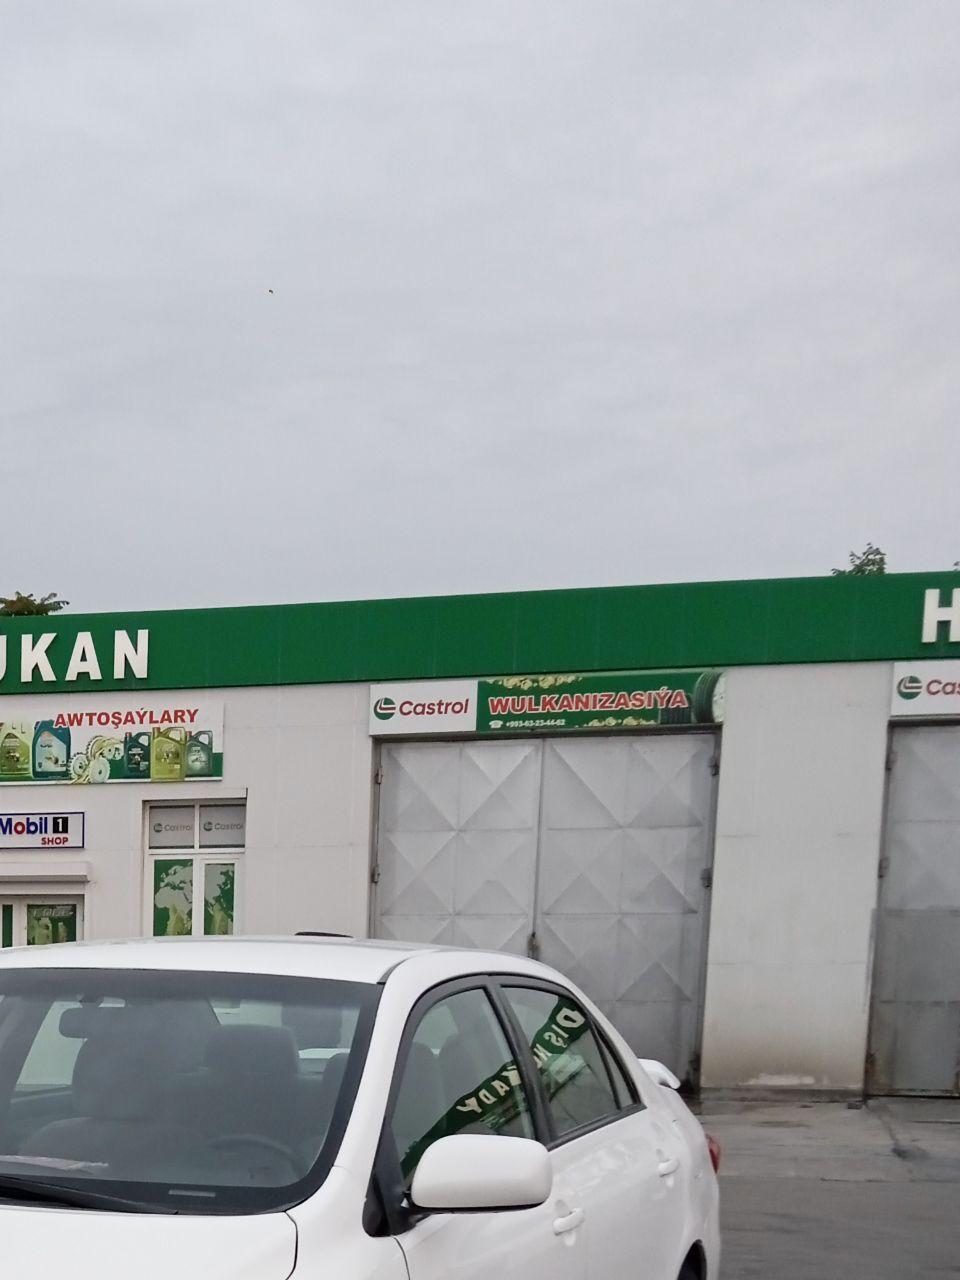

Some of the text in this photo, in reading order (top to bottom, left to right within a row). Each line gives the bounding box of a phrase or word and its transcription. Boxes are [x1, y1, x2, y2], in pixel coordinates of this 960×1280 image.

[399, 698, 470, 717] Castrol
[488, 686, 689, 716] WULKANIZASIÝA
[54, 707, 200, 729] AWTOŞAÝLARY
[54, 817, 66, 833] 1
[41, 837, 69, 845] SHOP
